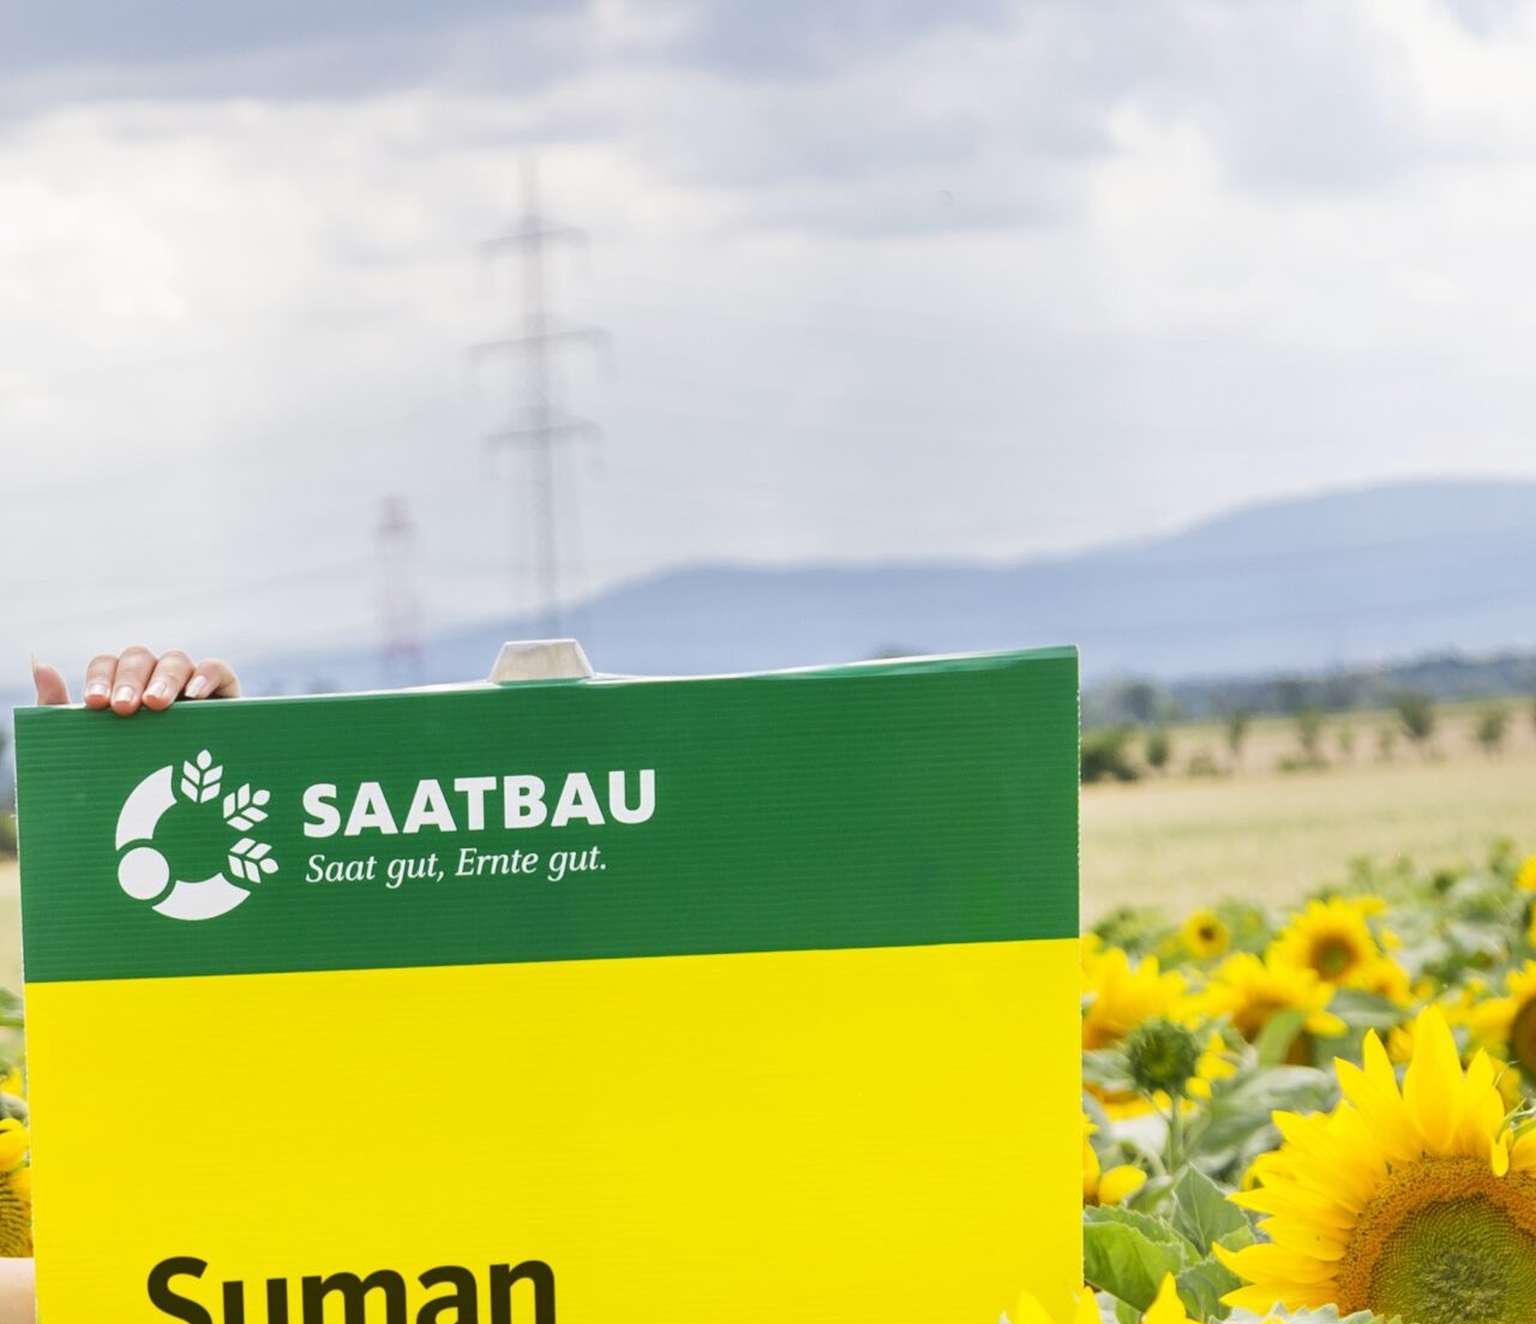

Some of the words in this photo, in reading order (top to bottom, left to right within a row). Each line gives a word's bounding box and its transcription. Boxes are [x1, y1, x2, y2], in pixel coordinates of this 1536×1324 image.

[302, 768, 656, 839] SAATBAU
[305, 854, 378, 883] Saat
[385, 853, 446, 889] gut,
[454, 847, 539, 876] Ernte
[547, 845, 608, 882] gut.
